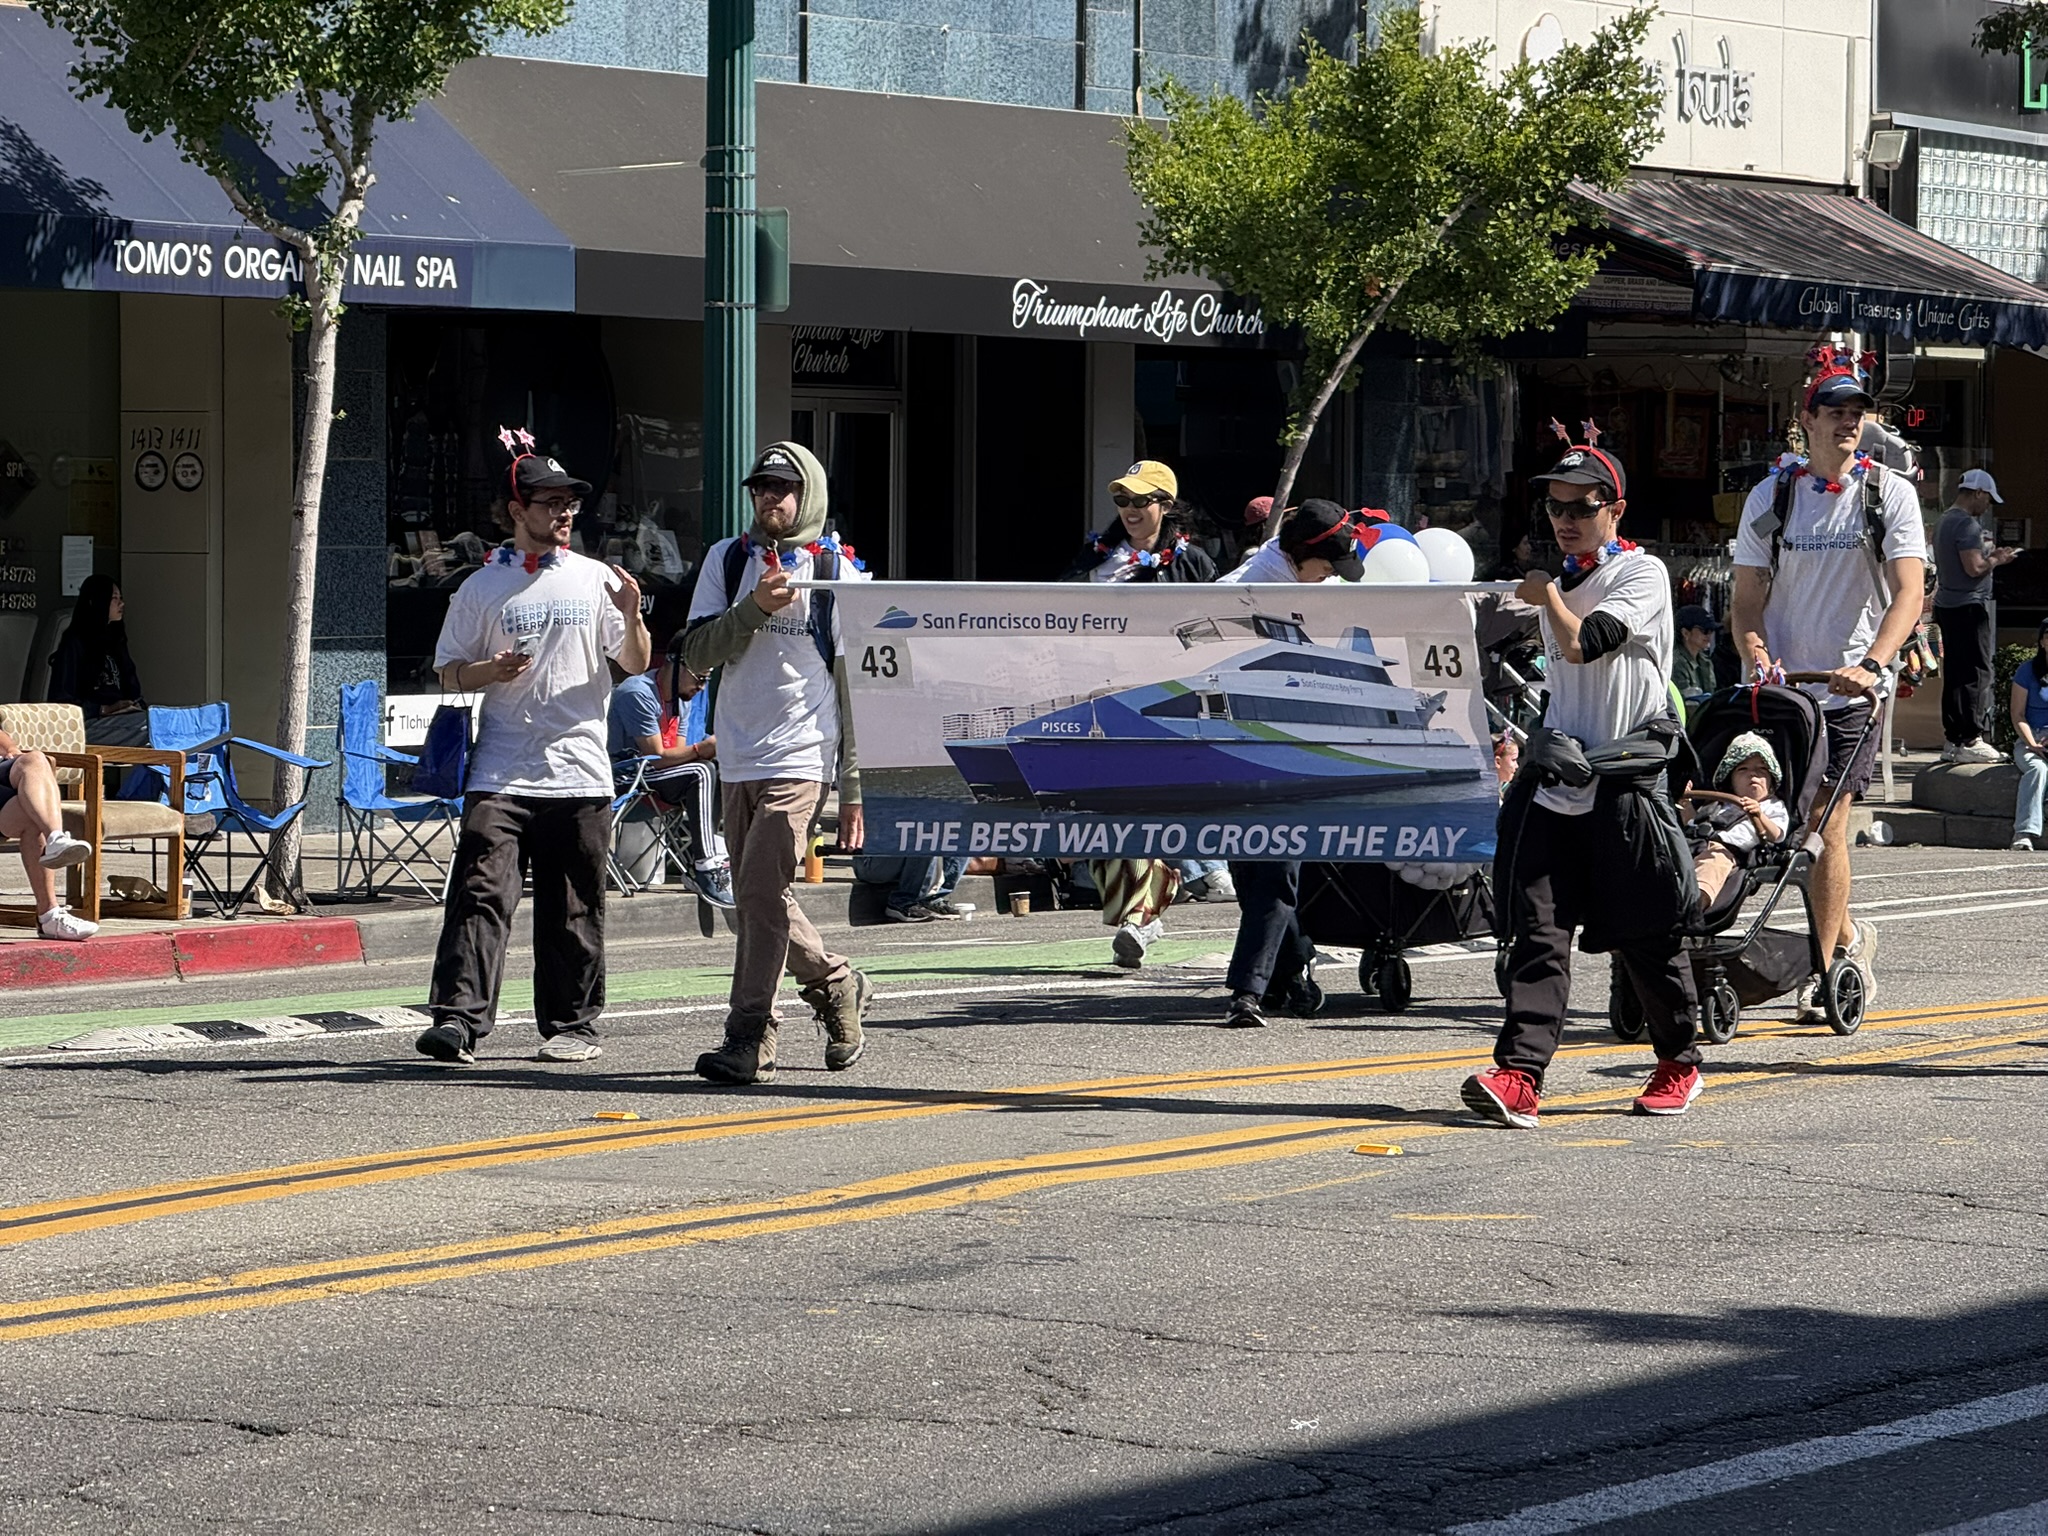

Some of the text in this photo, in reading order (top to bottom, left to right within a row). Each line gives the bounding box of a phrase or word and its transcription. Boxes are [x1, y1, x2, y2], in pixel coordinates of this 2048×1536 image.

[114, 239, 457, 288] TOMO'S ORGA NAIL SPA
[1012, 278, 1264, 343] Triumphant Life Church
[1799, 286, 1842, 315] Global
[1847, 291, 1901, 320] Treasures
[1918, 299, 1954, 333] Unique
[1958, 303, 1990, 331] Gifts
[793, 343, 850, 373] Church
[130, 426, 201, 450] 1413 1411
[6, 462, 24, 478] SPA
[1796, 541, 1858, 551] FERRY RIDER
[514, 600, 590, 614] FERRY RIDERS
[515, 610, 550, 623] FERRY
[553, 608, 590, 617] RIDERS
[516, 618, 549, 633] FERRY
[553, 617, 589, 626] RIDERS
[923, 612, 1128, 633] San Francisco Bay Ferry
[861, 645, 899, 678] 43
[1424, 645, 1463, 678] 43
[1041, 721, 1081, 733] PISCES
[895, 821, 1467, 857] THE BEST WAY TO CROSS THE BAY
